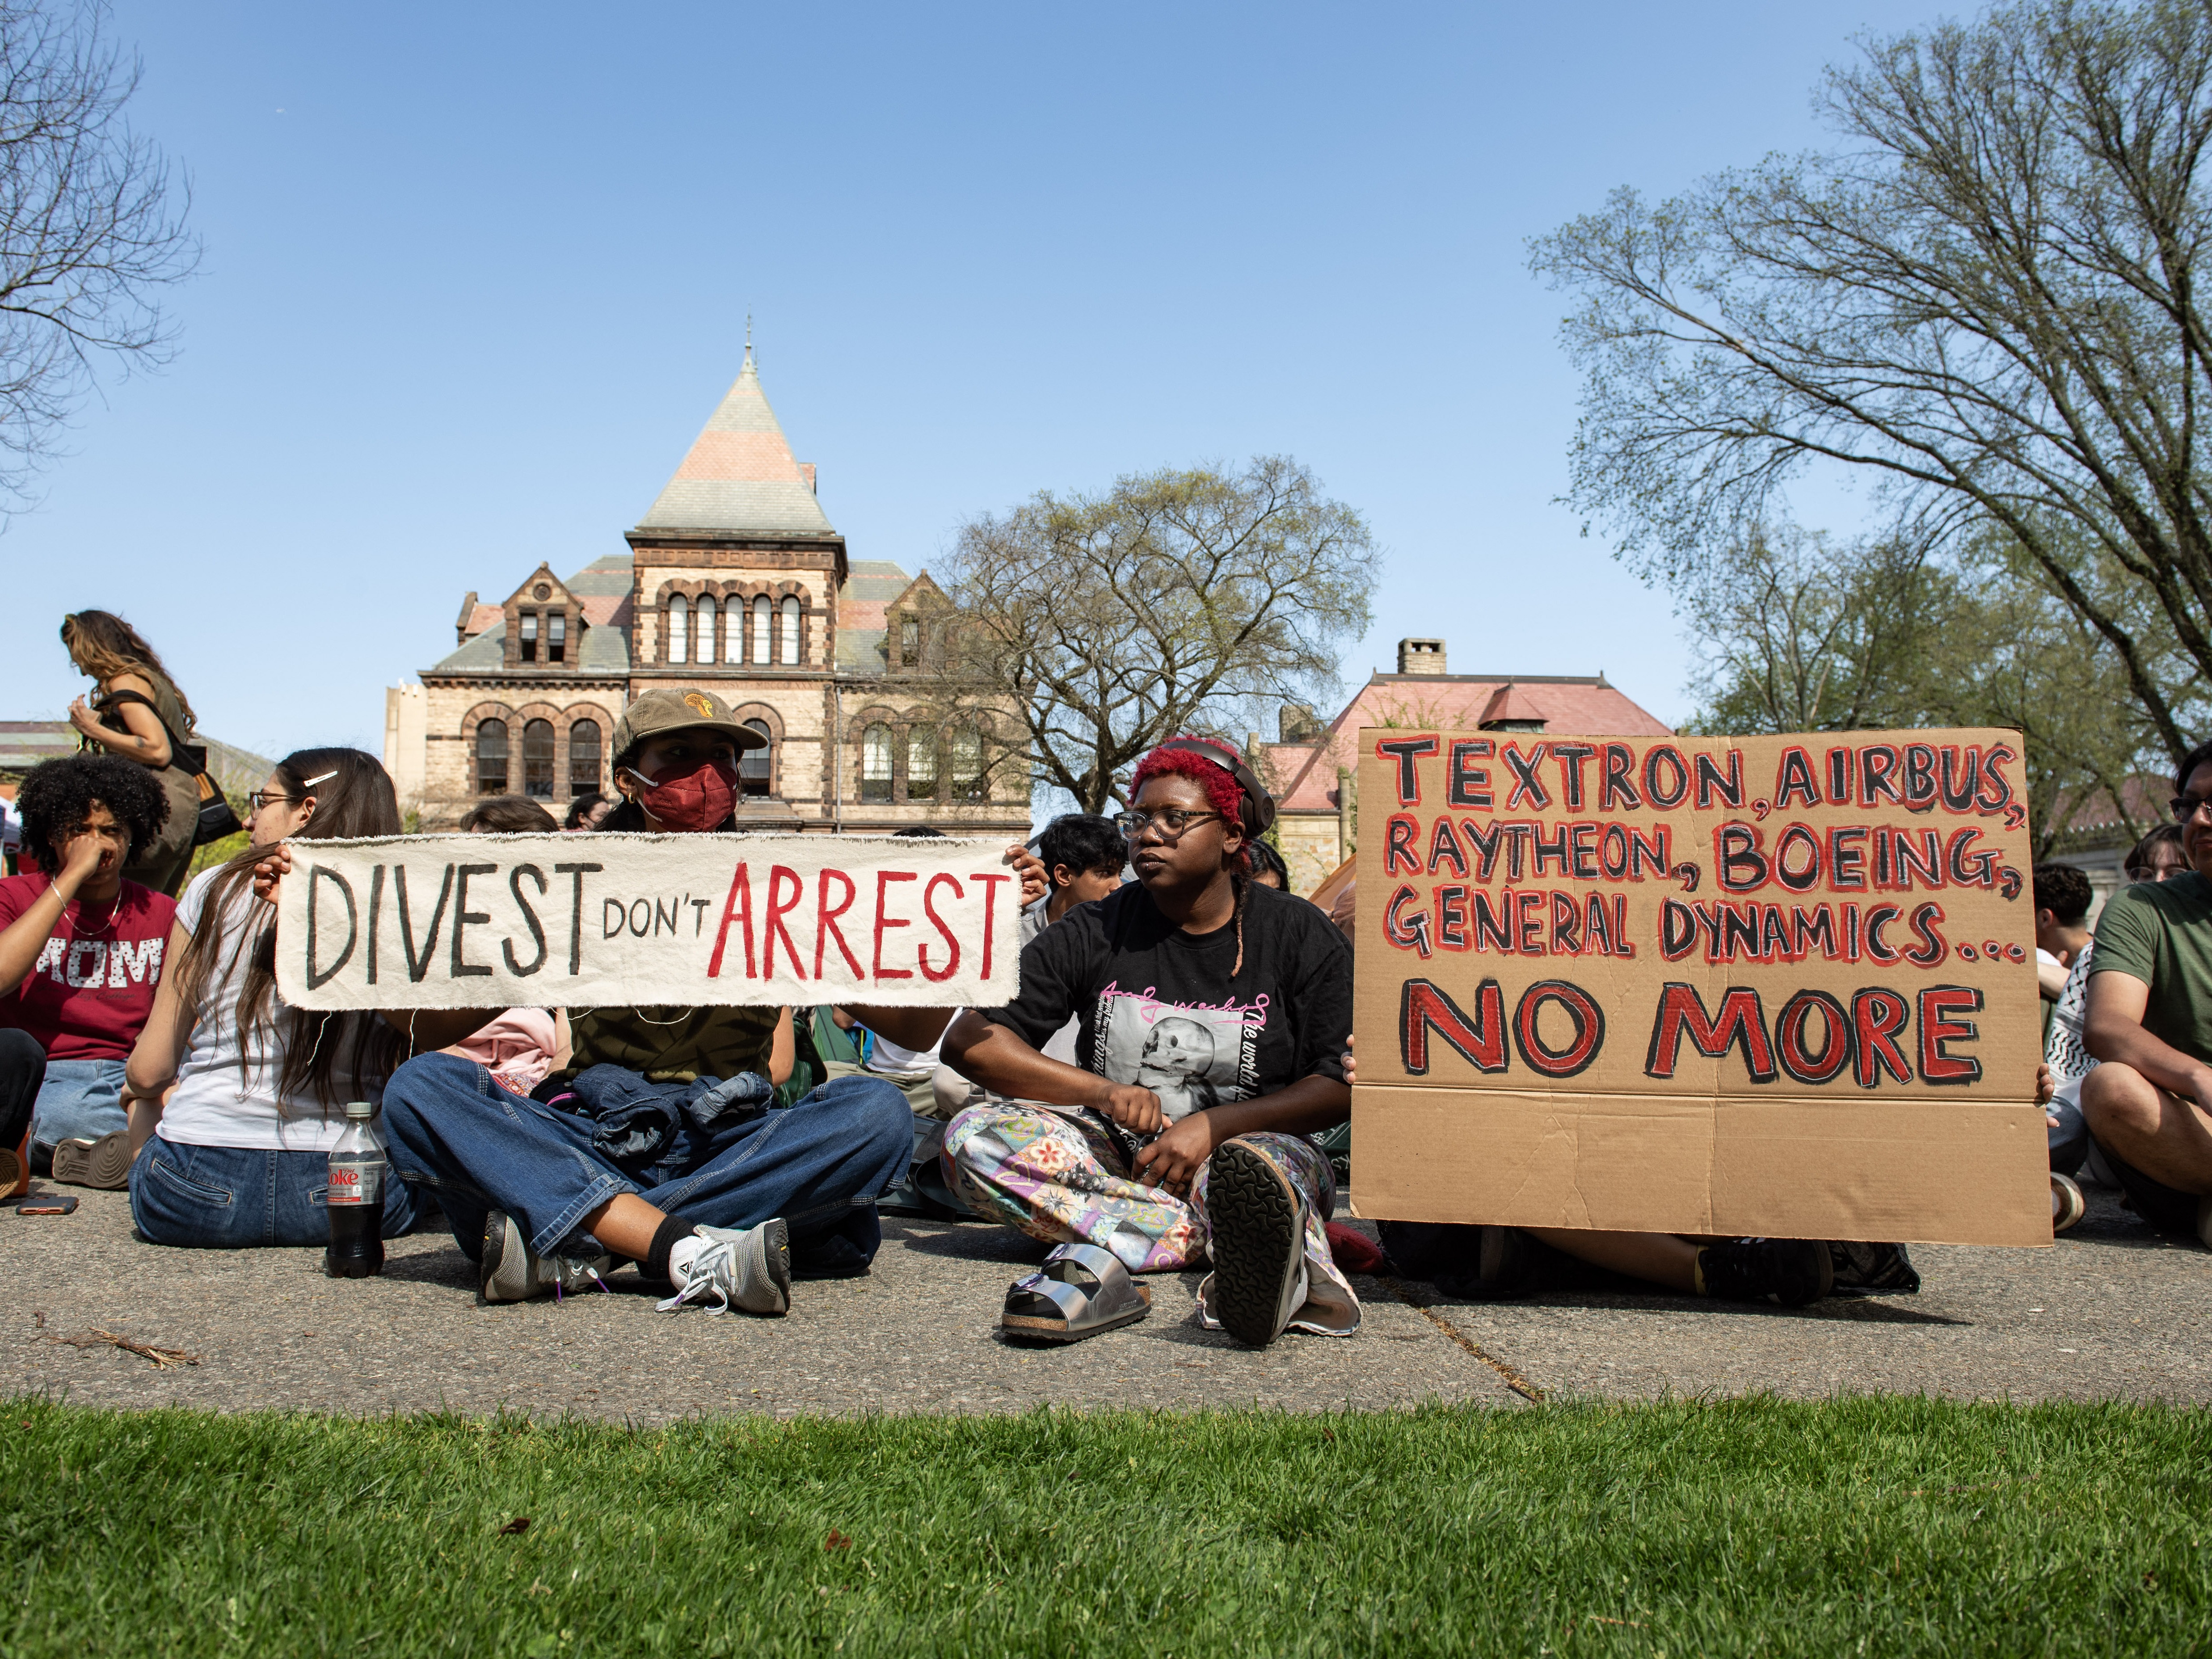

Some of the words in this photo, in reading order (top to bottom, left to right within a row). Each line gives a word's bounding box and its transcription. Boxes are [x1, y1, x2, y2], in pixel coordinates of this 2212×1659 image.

[1376, 733, 1771, 821] TEXTRON,
[1773, 741, 2027, 831] AIRBUS,
[1383, 812, 1701, 892] RAYTHEON,
[1713, 820, 2024, 901] BOEING,
[307, 863, 605, 991] DIVEST
[603, 893, 712, 940] DON'T
[707, 858, 1012, 987] ARREST
[1383, 883, 1636, 960] GENERAL
[1103, 1016, 1112, 1027] my
[1239, 1041, 1260, 1086] world
[1399, 976, 1605, 1078] NO
[1642, 982, 1984, 1090] MORE
